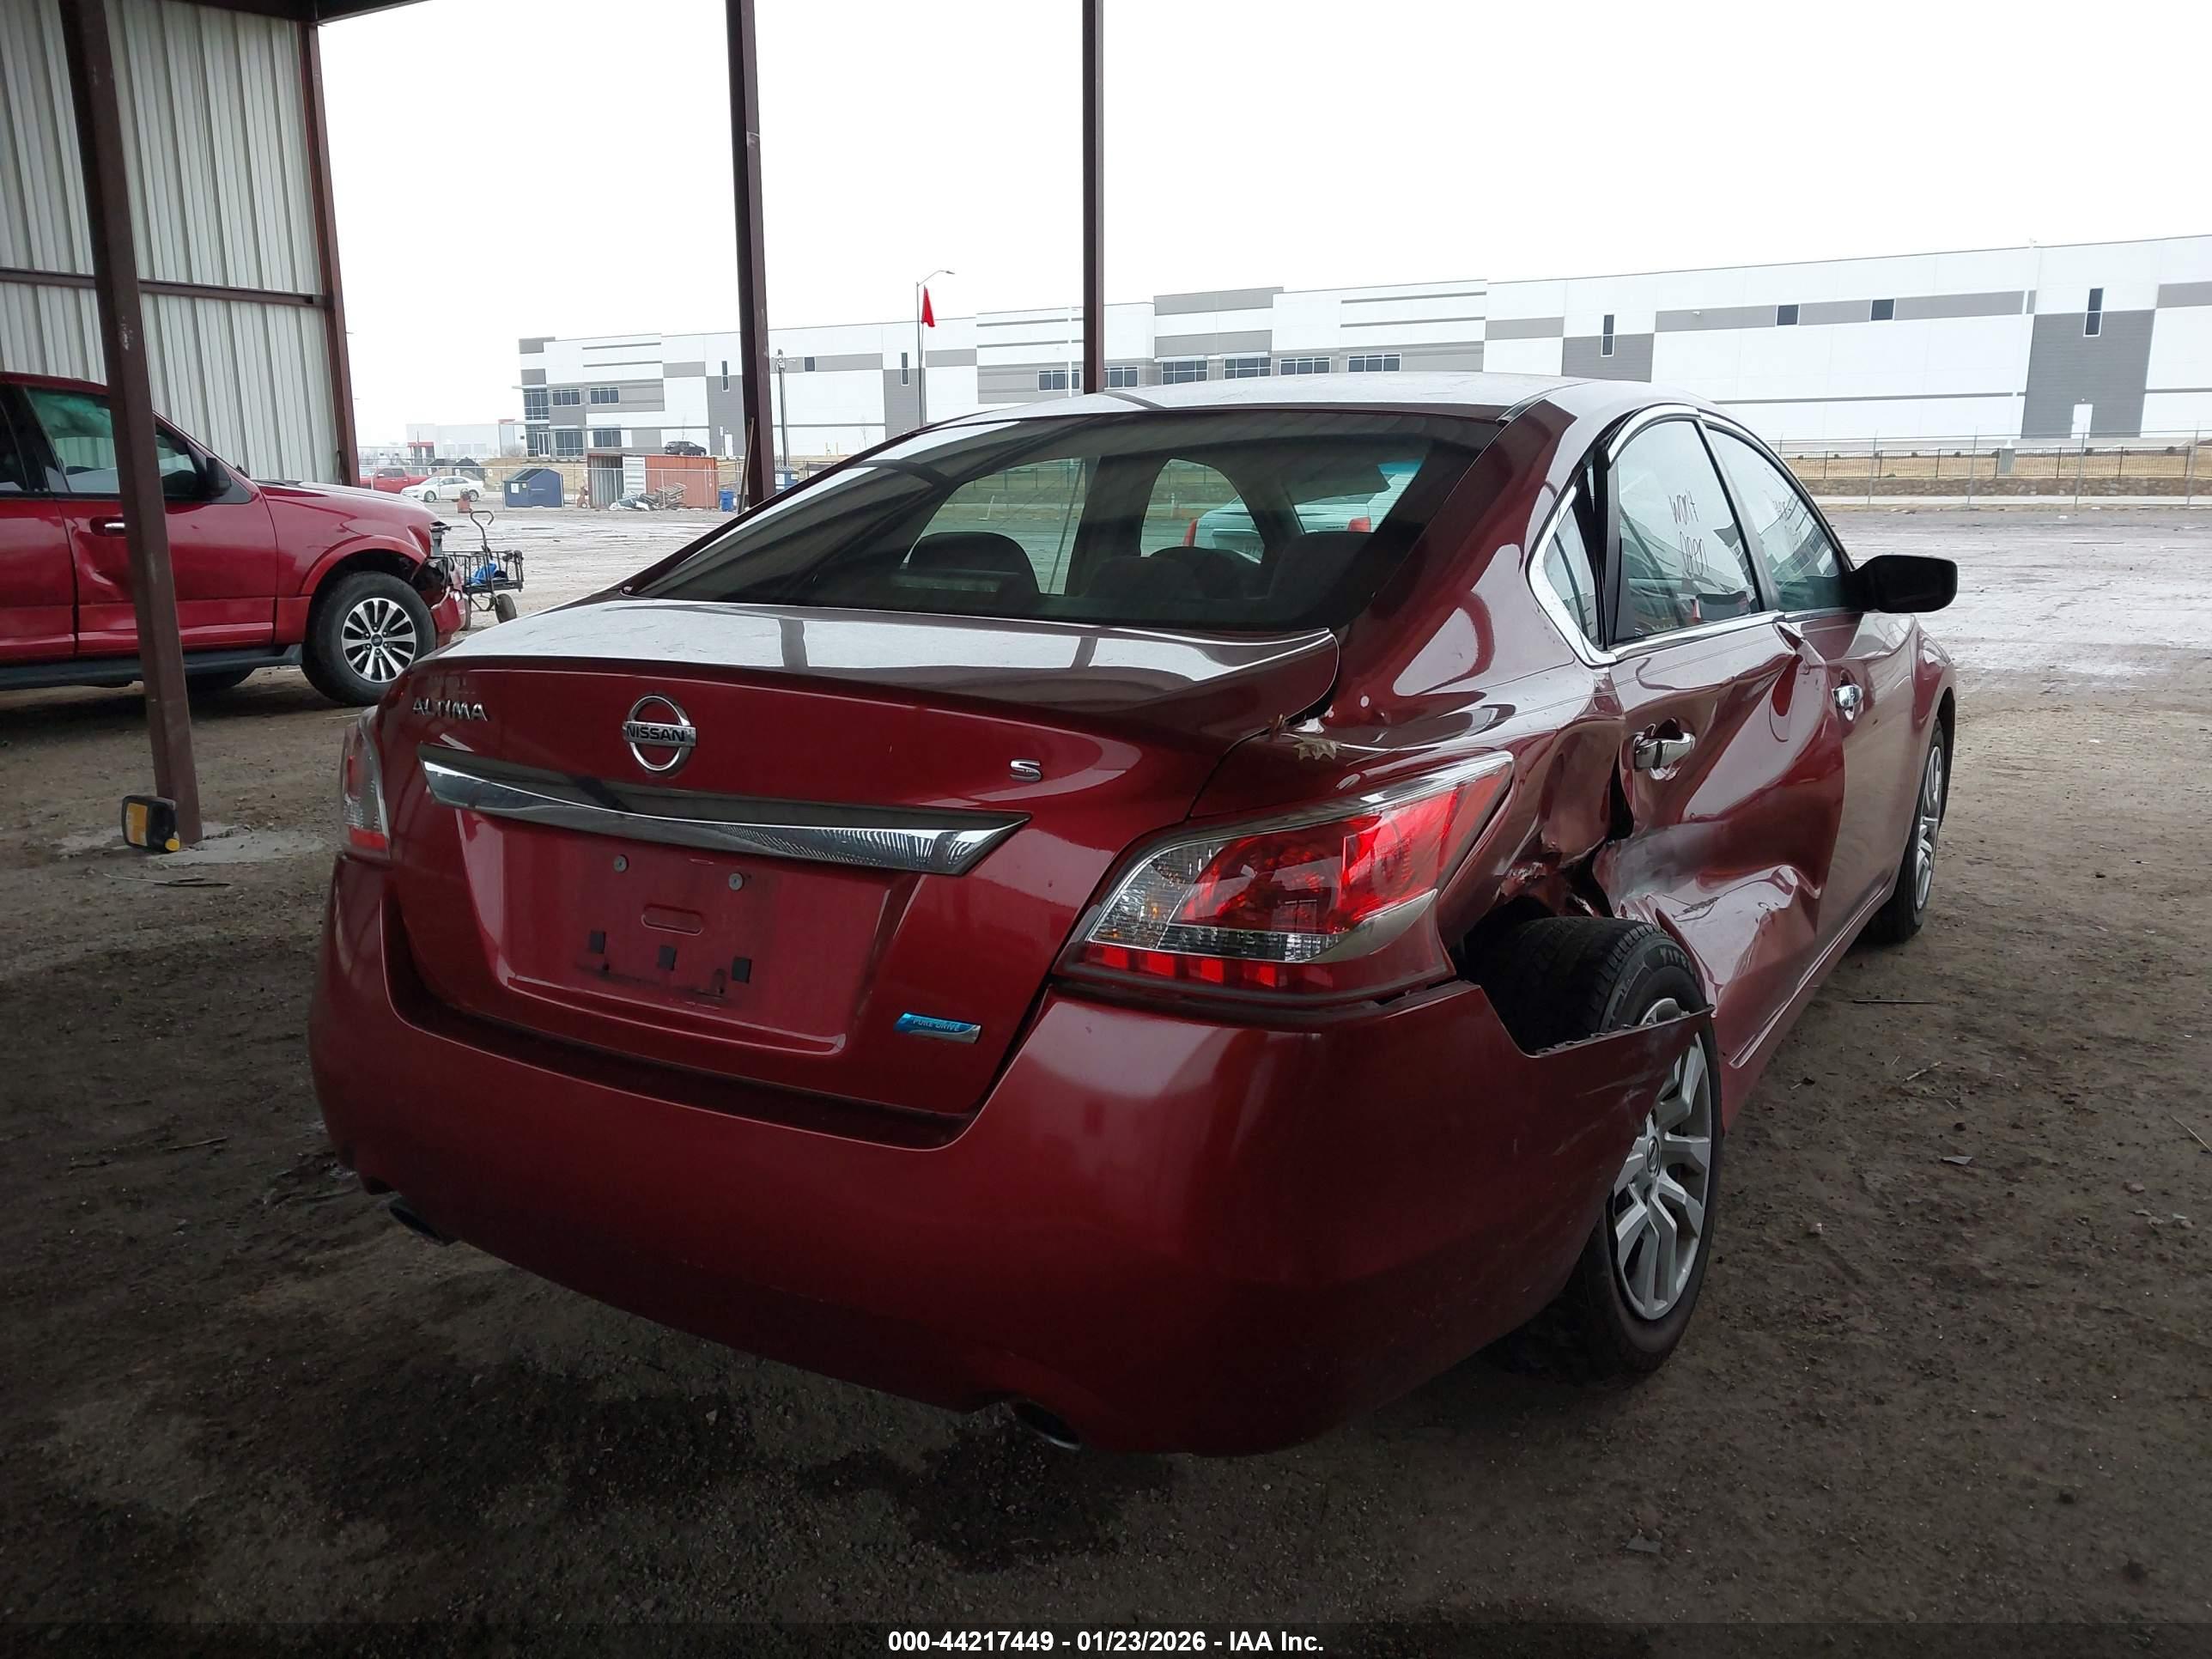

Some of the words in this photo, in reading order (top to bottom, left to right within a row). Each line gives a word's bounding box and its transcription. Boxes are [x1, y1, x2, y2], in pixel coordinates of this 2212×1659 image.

[412, 697, 488, 721] ALTIMA
[626, 726, 685, 741] NISSAN
[1010, 759, 1042, 781] S
[912, 1018, 933, 1028] PURE
[935, 1023, 961, 1032] DRIVE
